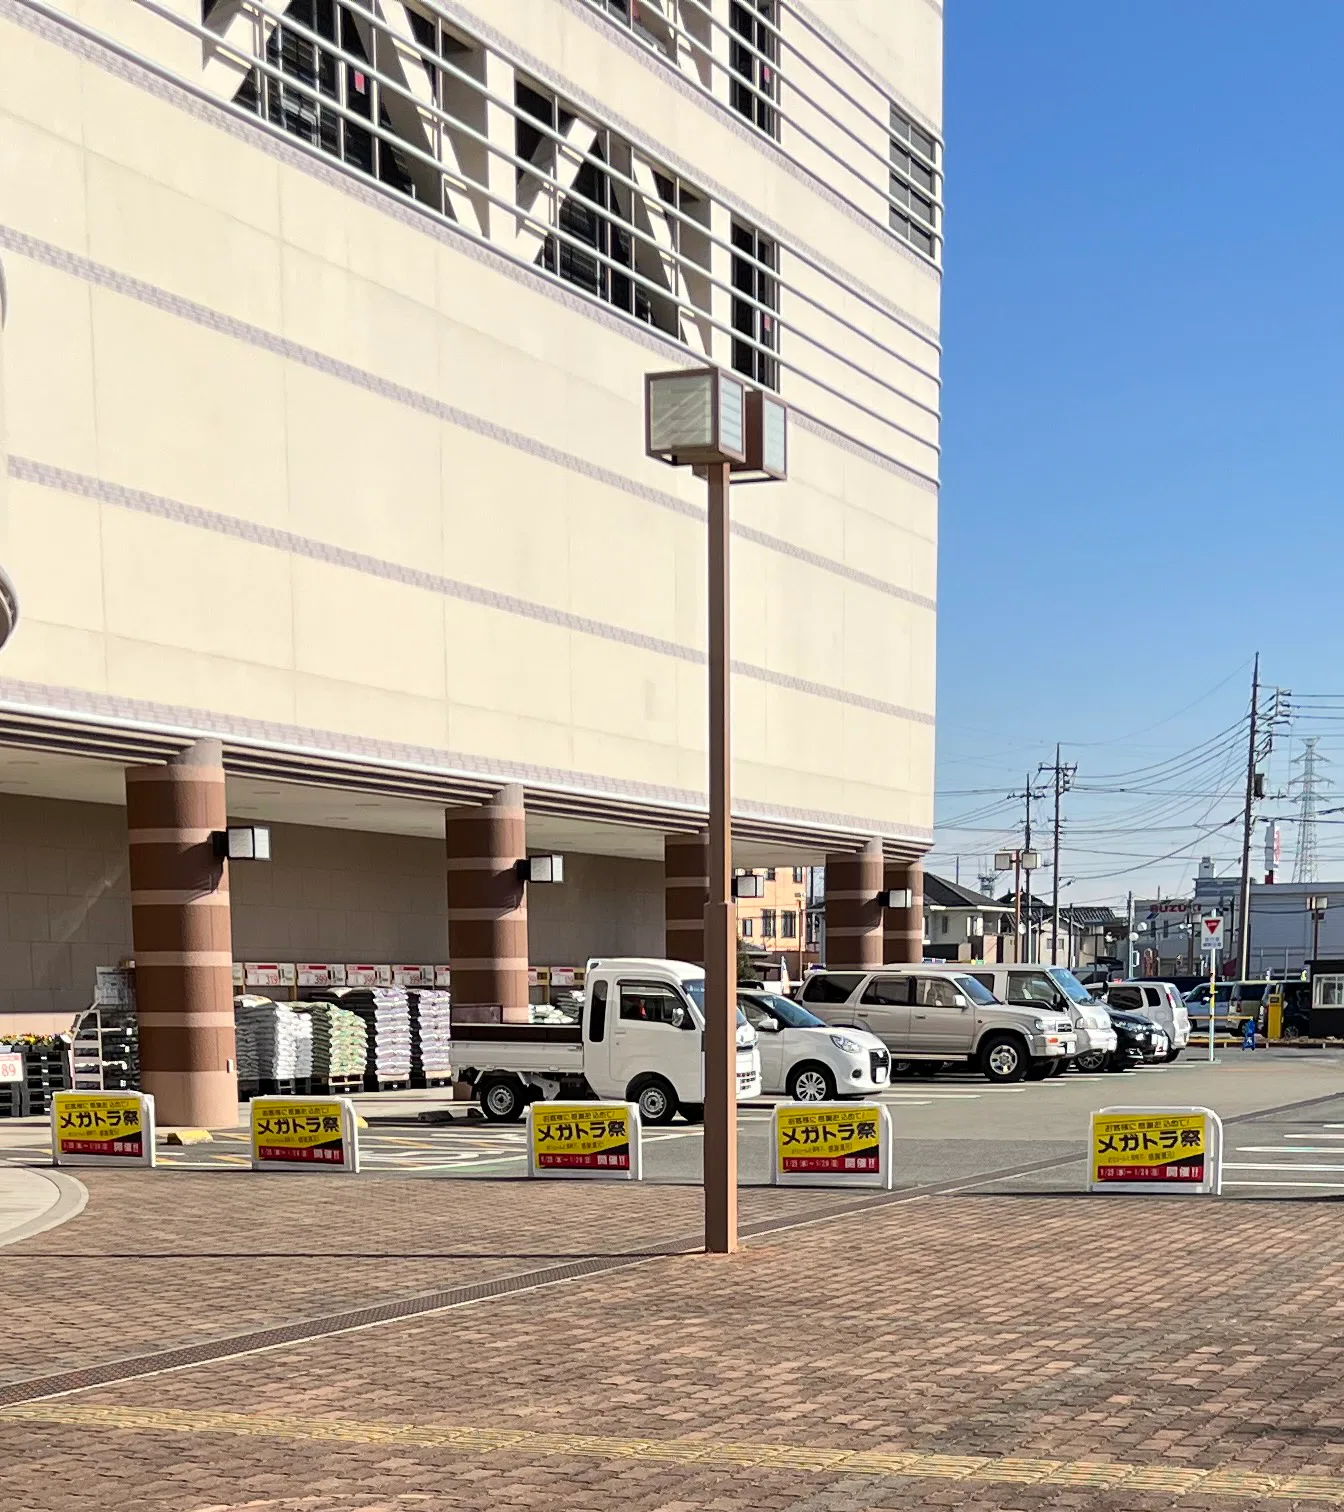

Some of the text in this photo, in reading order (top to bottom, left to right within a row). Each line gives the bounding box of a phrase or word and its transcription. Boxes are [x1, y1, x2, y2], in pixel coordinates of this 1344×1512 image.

[1, 1064, 16, 1077] 89
[60, 1111, 139, 1128] メガトラ祭
[258, 1117, 339, 1134] メガトラ祭
[538, 1121, 625, 1141] メガトラ祭
[783, 1123, 876, 1145] メガトラ祭
[1098, 1130, 1200, 1153] メガトラ祭
